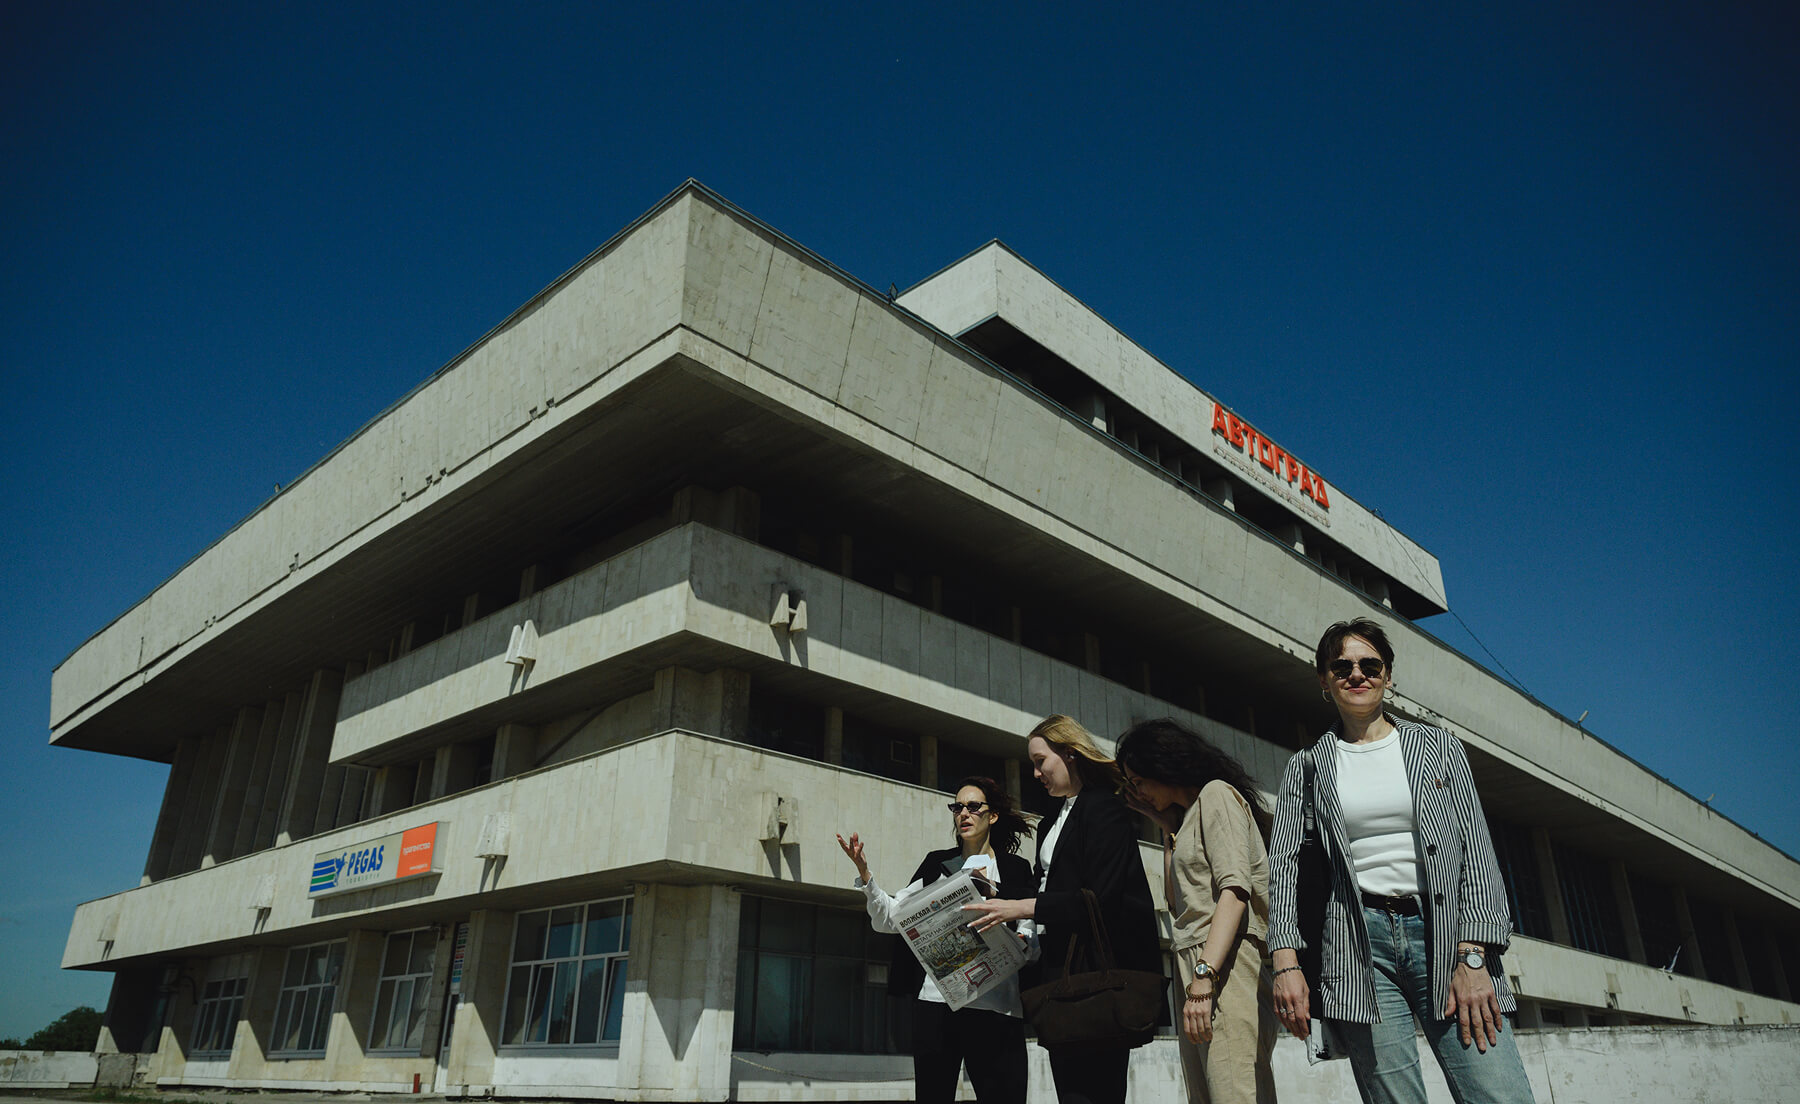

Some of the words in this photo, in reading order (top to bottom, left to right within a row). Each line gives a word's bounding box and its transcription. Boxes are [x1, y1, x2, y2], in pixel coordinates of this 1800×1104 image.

[1212, 402, 1330, 508] АВТОГРАД
[347, 845, 385, 877] PEGAS
[940, 885, 969, 906] КОММУНА
